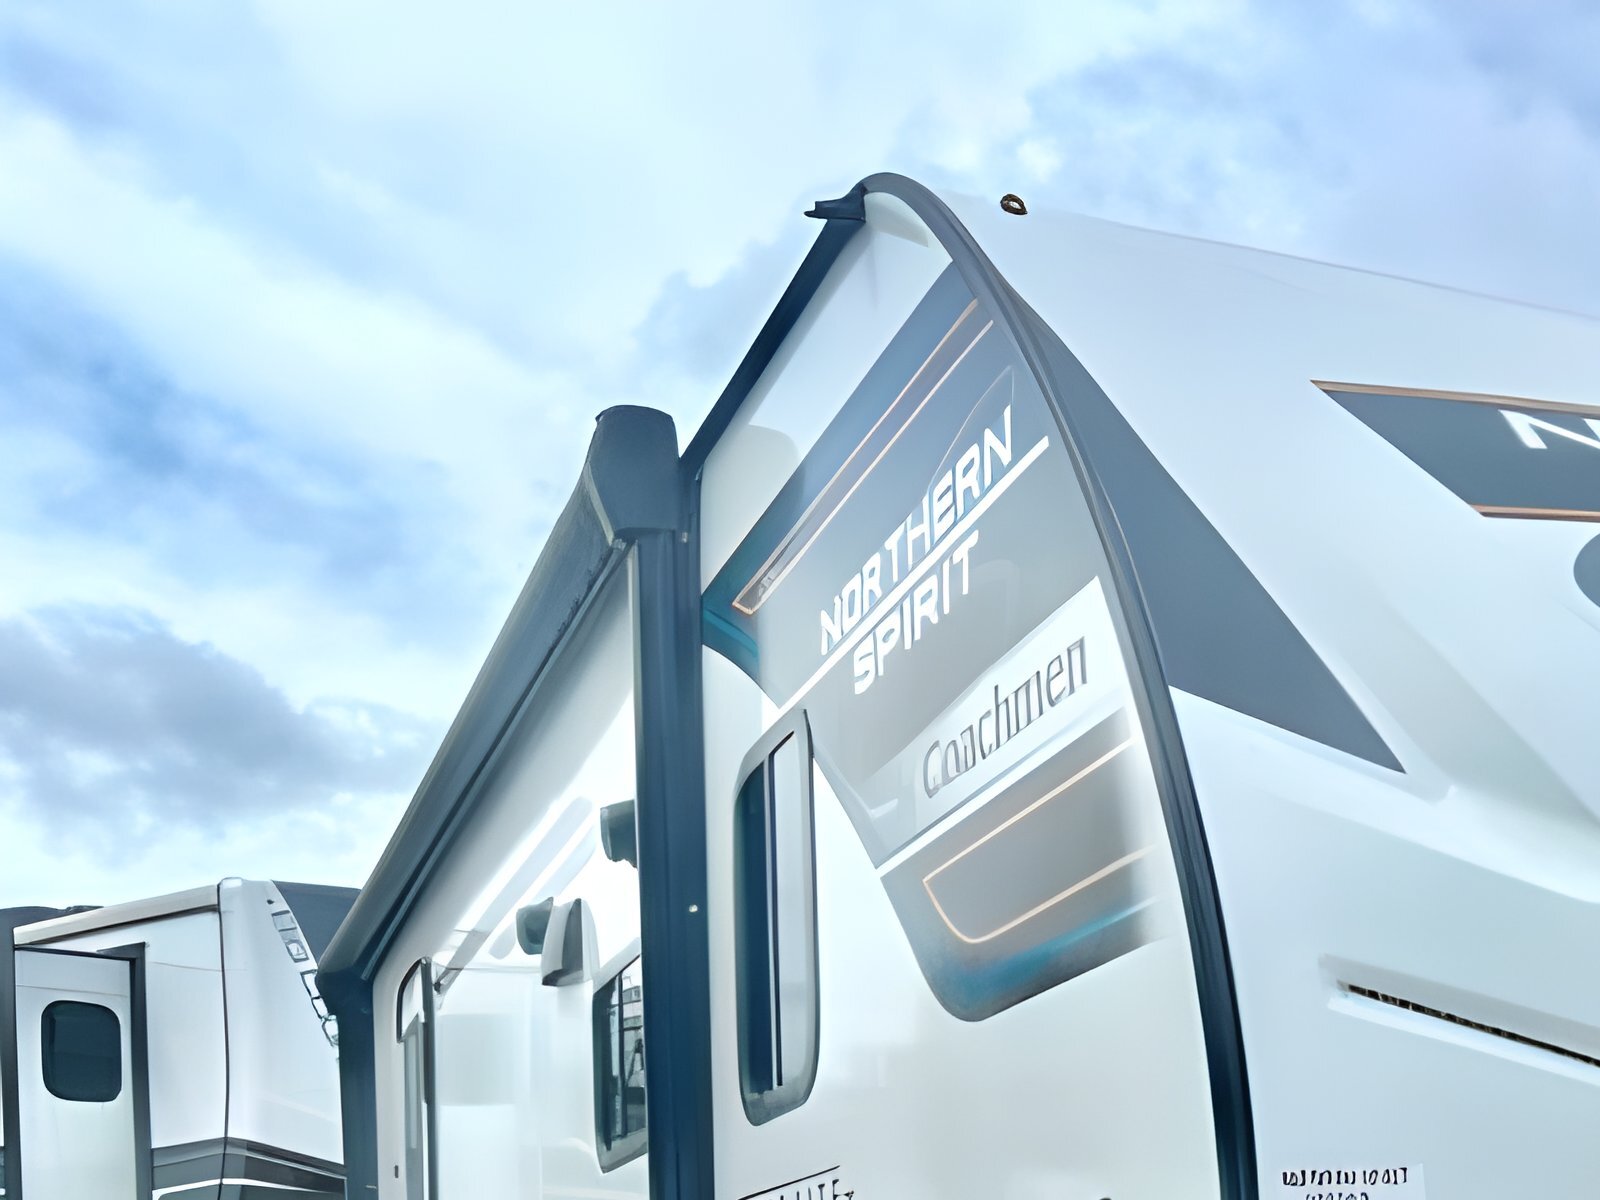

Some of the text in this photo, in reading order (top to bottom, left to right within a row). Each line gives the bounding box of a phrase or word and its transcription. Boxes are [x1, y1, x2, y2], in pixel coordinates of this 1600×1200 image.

[820, 403, 1012, 656] NORTHERN
[853, 528, 979, 695] SPIRIT
[923, 635, 1089, 799] Coachmen
